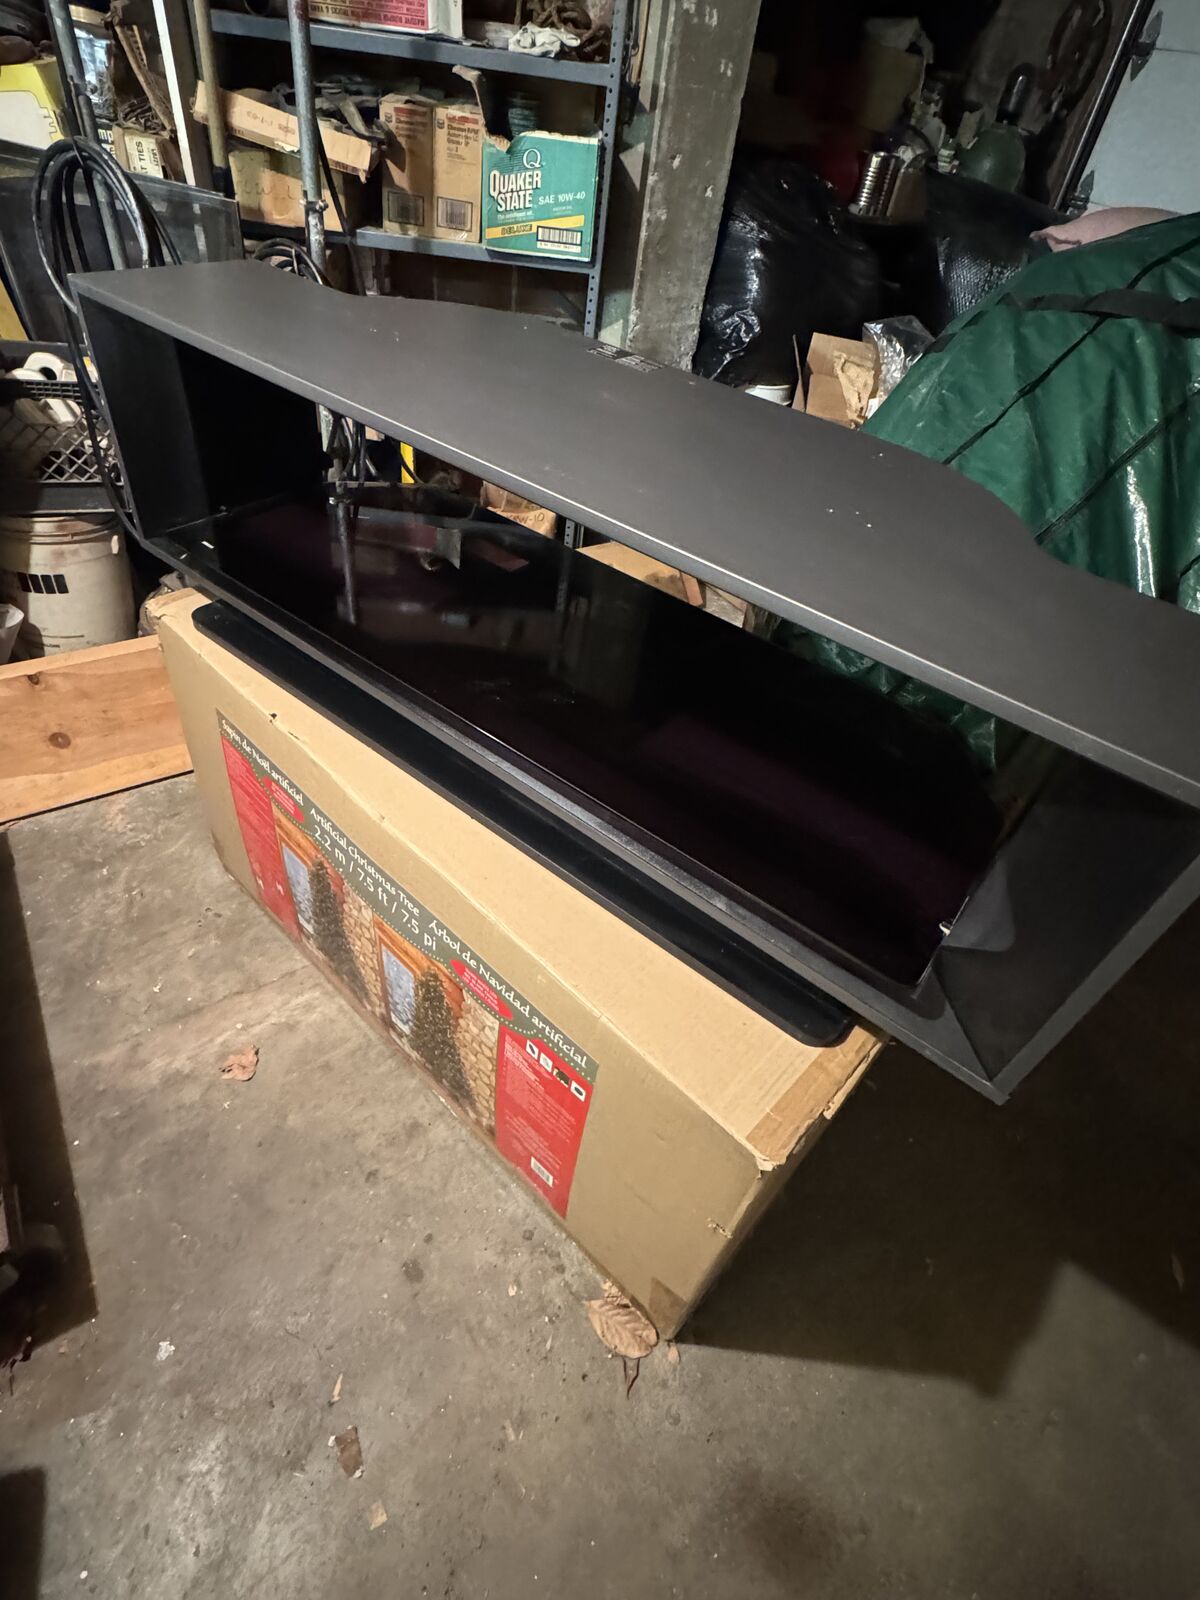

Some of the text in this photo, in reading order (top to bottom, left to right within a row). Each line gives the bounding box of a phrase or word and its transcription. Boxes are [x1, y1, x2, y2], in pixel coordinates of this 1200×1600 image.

[135, 141, 146, 162] TIES
[522, 148, 542, 169] Q
[489, 169, 541, 197] QUAKER
[497, 190, 533, 213] STATE
[538, 191, 586, 206] SAE 10W-40
[310, 807, 420, 917] Artificial Christmas Tree
[314, 824, 332, 851] 2.2
[334, 847, 346, 865] m
[357, 867, 374, 892] 7.5
[377, 886, 388, 906] ft
[401, 908, 419, 934] 7.5
[423, 932, 436, 951] pi
[462, 950, 477, 969] de
[479, 963, 530, 1018] Navidad
[531, 1014, 588, 1069] artificial
